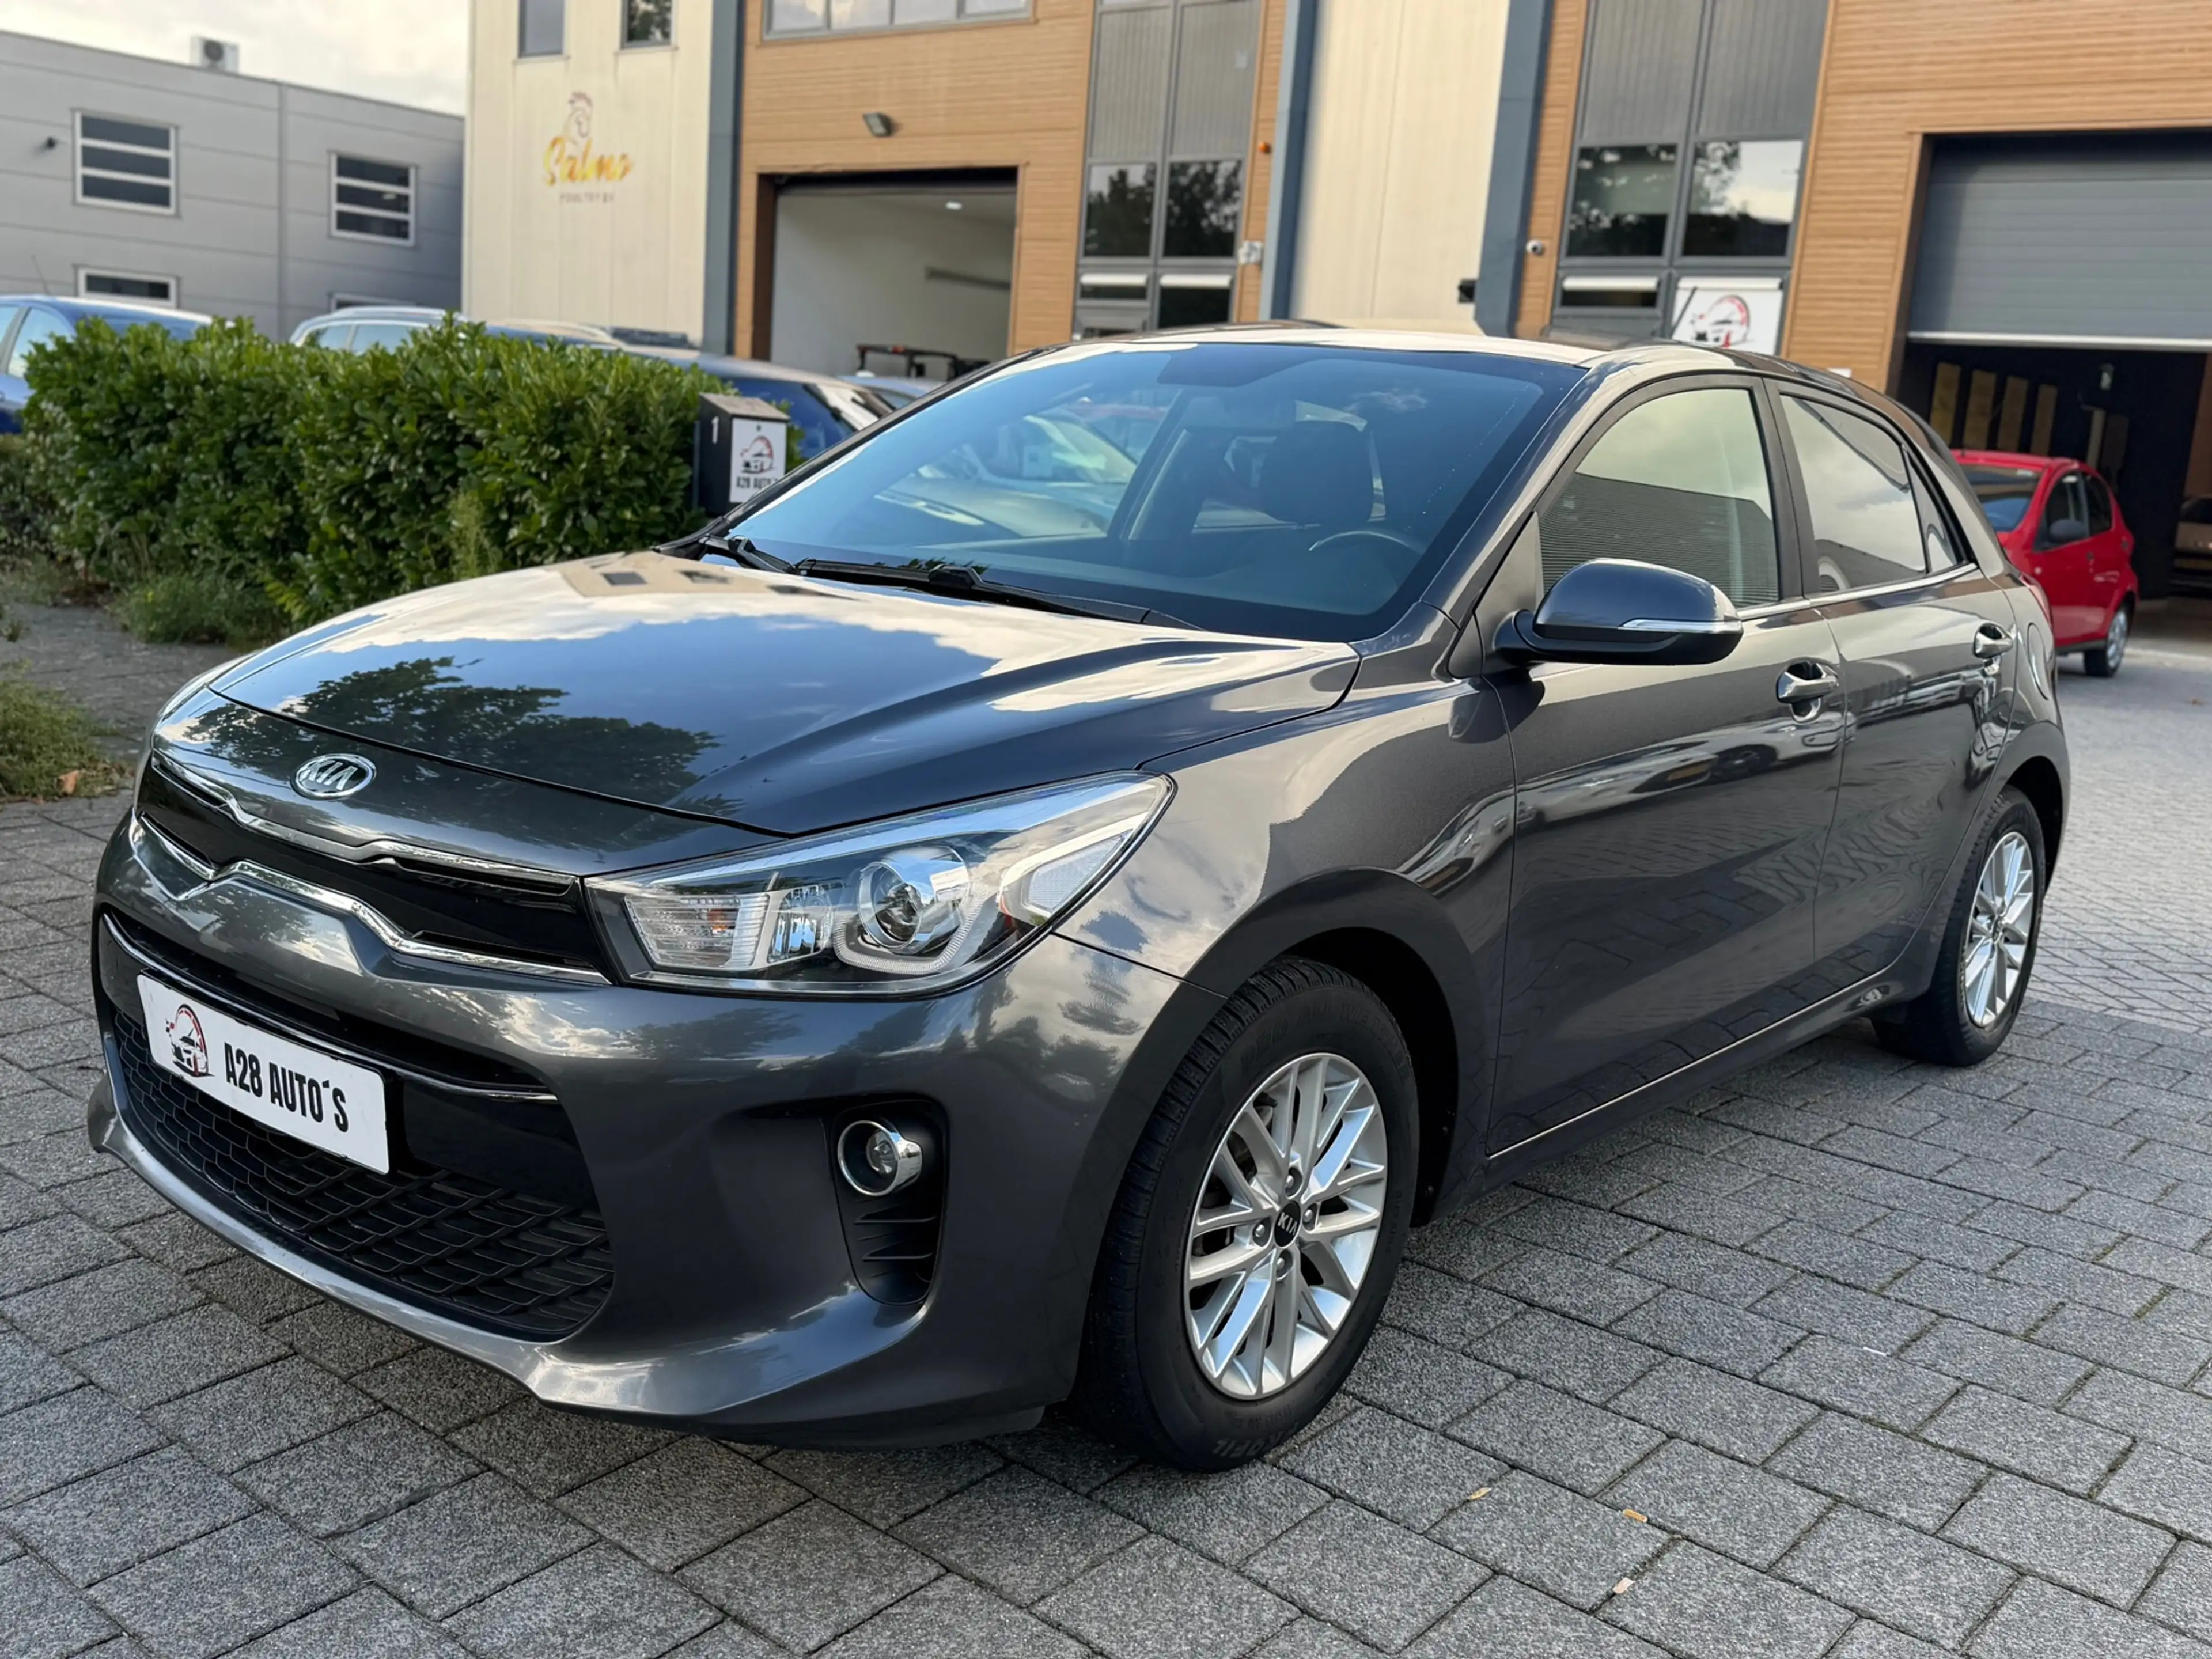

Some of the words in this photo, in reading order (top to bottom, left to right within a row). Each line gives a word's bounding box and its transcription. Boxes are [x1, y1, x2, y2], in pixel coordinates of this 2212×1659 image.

[710, 415, 719, 444] 1
[298, 759, 358, 791] KIA
[224, 1041, 263, 1099] A28
[1277, 1211, 1298, 1236] KIA
